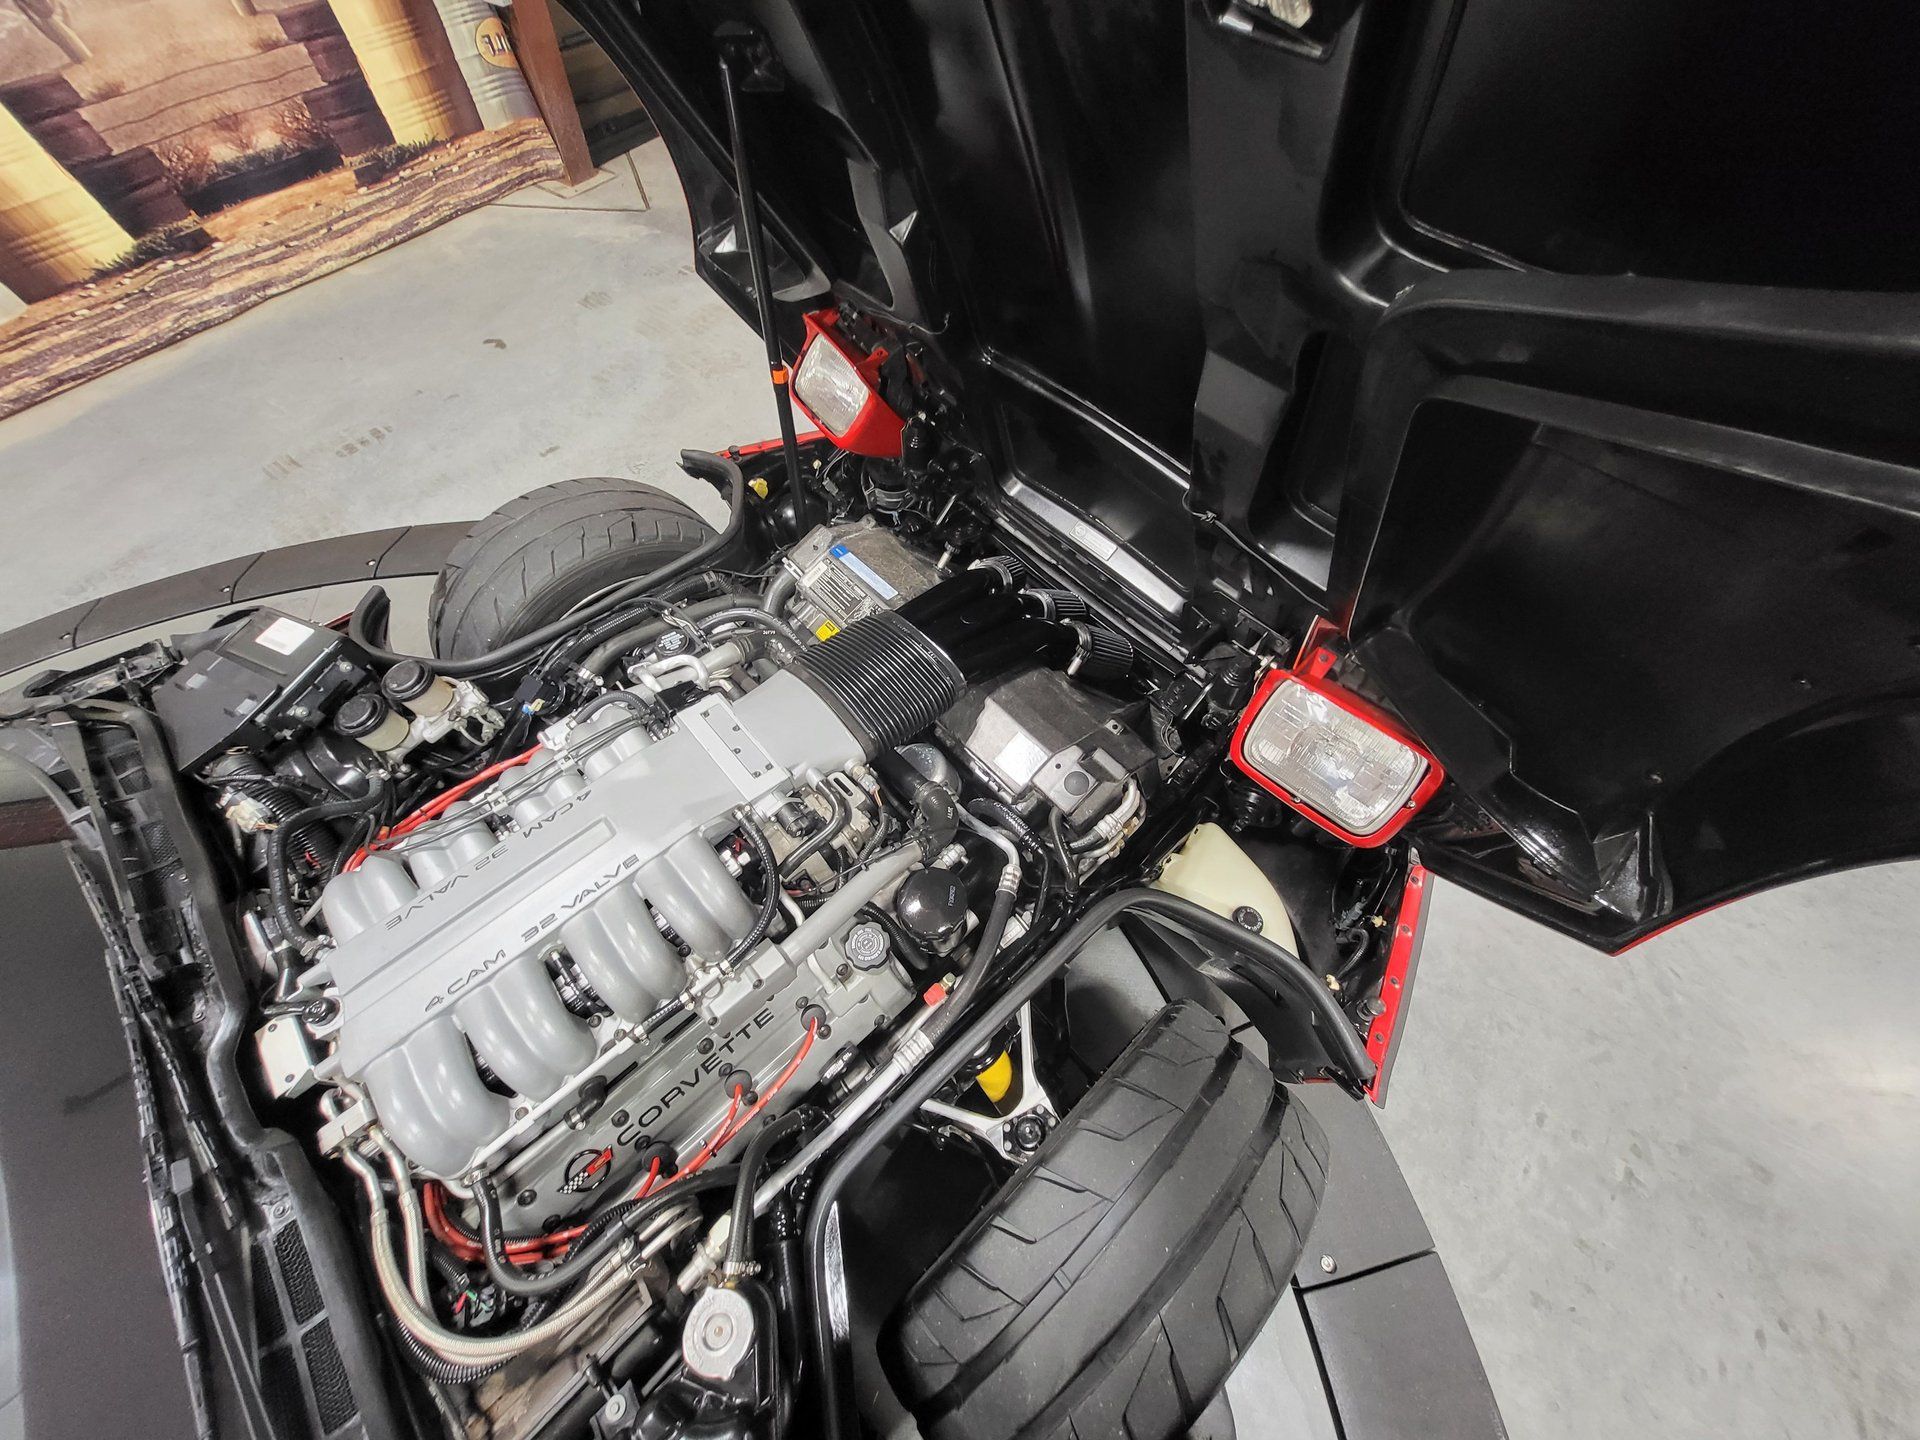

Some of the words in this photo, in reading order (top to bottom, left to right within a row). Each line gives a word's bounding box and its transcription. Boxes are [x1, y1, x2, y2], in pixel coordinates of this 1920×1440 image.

[577, 789, 592, 801] 4
[523, 802, 574, 838] CAM
[475, 845, 509, 871] 32
[385, 874, 469, 931] VALVE
[425, 995, 445, 1012] 4
[447, 949, 507, 995] CAM
[521, 913, 559, 943] 32
[561, 854, 640, 908] VALVE
[616, 1008, 775, 1147] CORVETTE
